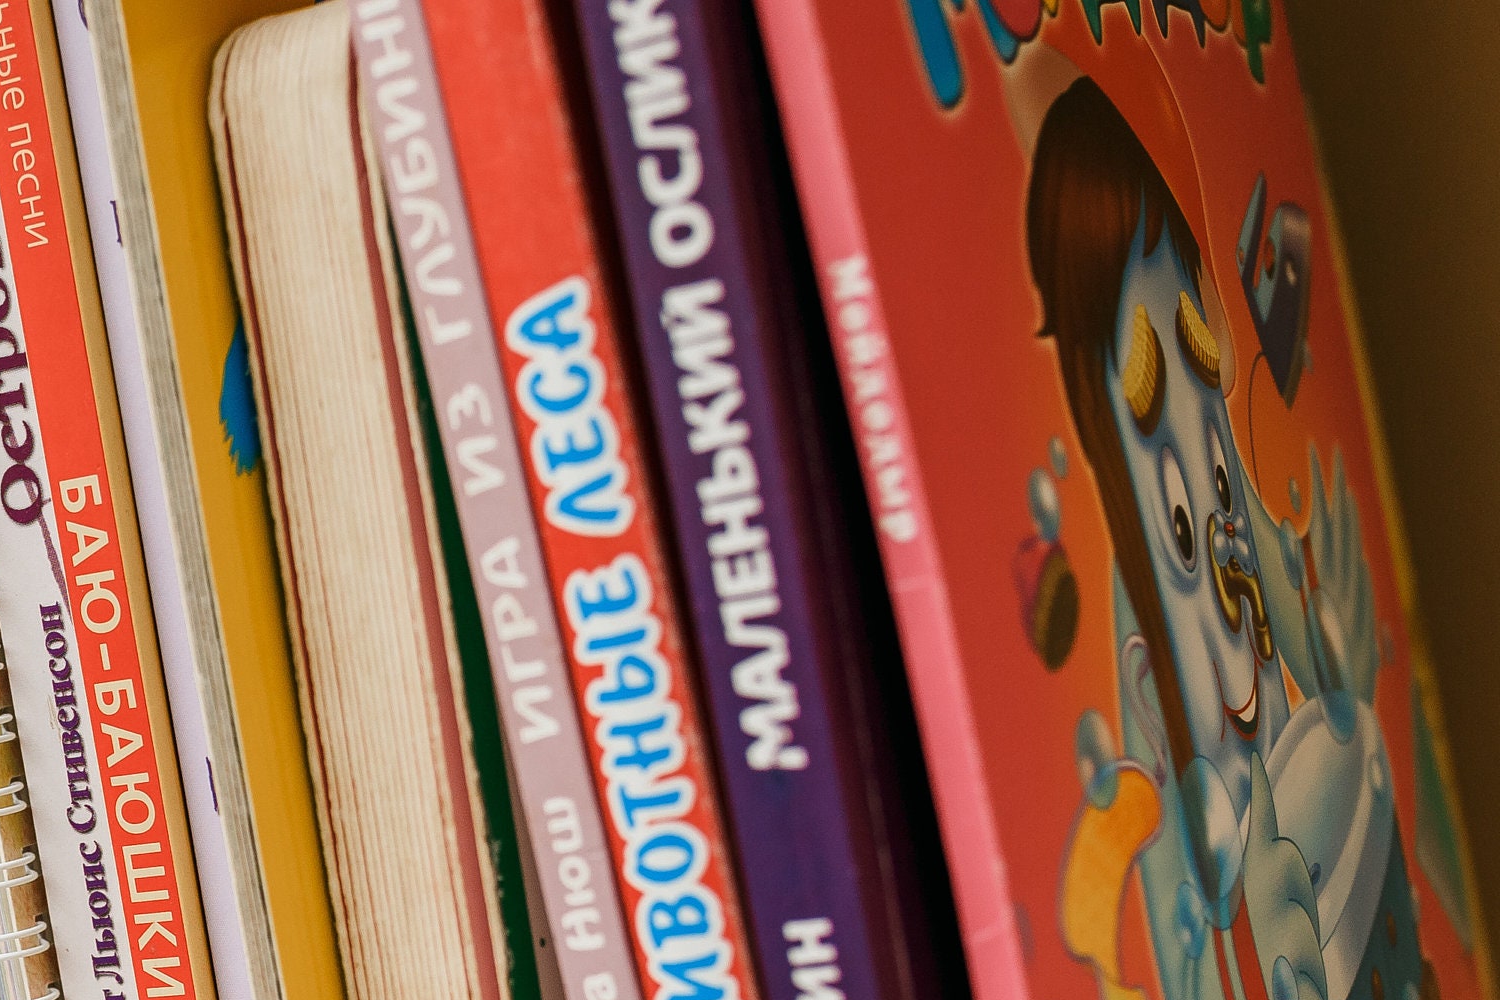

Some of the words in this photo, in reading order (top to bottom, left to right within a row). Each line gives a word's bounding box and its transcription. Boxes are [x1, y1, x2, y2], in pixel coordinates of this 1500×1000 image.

[7, 121, 52, 250] песни
[357, 0, 475, 347] ГЛУБИН
[446, 381, 507, 498] ИЗ
[506, 276, 633, 533] ЛЕСА
[661, 277, 810, 773] МАЛЕНЬКИЙ
[37, 599, 98, 835] Стивенсон
[479, 534, 563, 746] ИГРА
[77, 838, 125, 983] Льюис
[542, 795, 607, 953] Нюш
